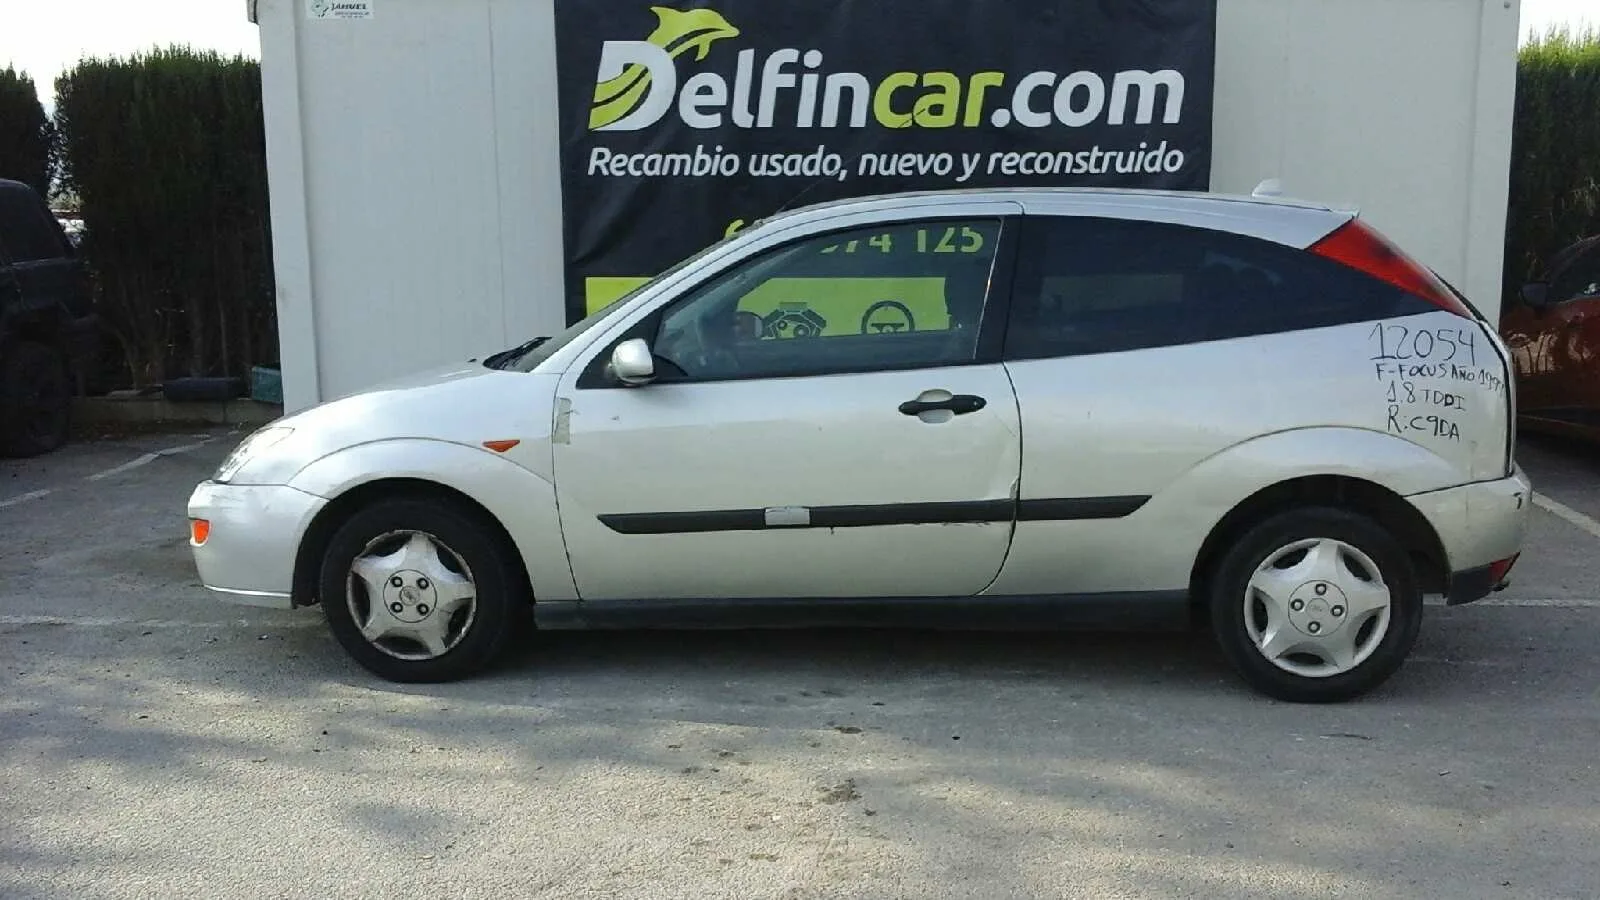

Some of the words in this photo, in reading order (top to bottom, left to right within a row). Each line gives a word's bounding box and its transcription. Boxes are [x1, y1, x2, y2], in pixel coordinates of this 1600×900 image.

[588, 40, 1184, 132] Delfincar.com
[587, 144, 740, 177] Recambio
[749, 144, 848, 181] usado,
[858, 152, 953, 177] nuevo
[955, 152, 981, 182] y
[987, 140, 1184, 175] reconstruido
[1368, 322, 1475, 366] 12054
[1386, 380, 1416, 404] 1.8
[1420, 389, 1466, 411] TDDI
